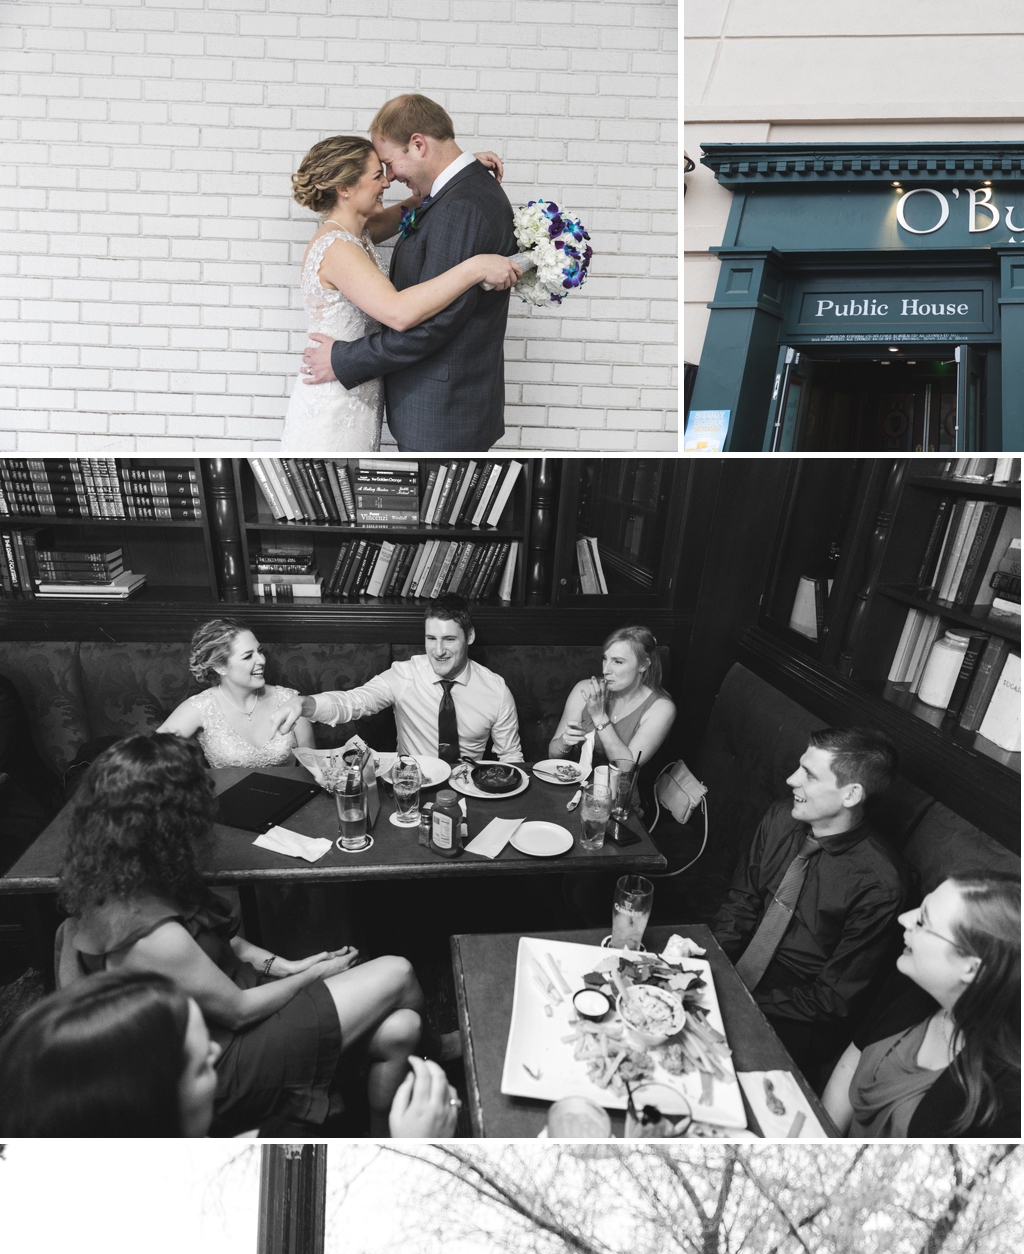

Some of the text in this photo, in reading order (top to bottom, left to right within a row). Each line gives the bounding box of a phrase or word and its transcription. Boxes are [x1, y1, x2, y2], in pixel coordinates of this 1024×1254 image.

[815, 298, 969, 317] Public House
[967, 511, 990, 566] CRITICAL CONDITIONS
